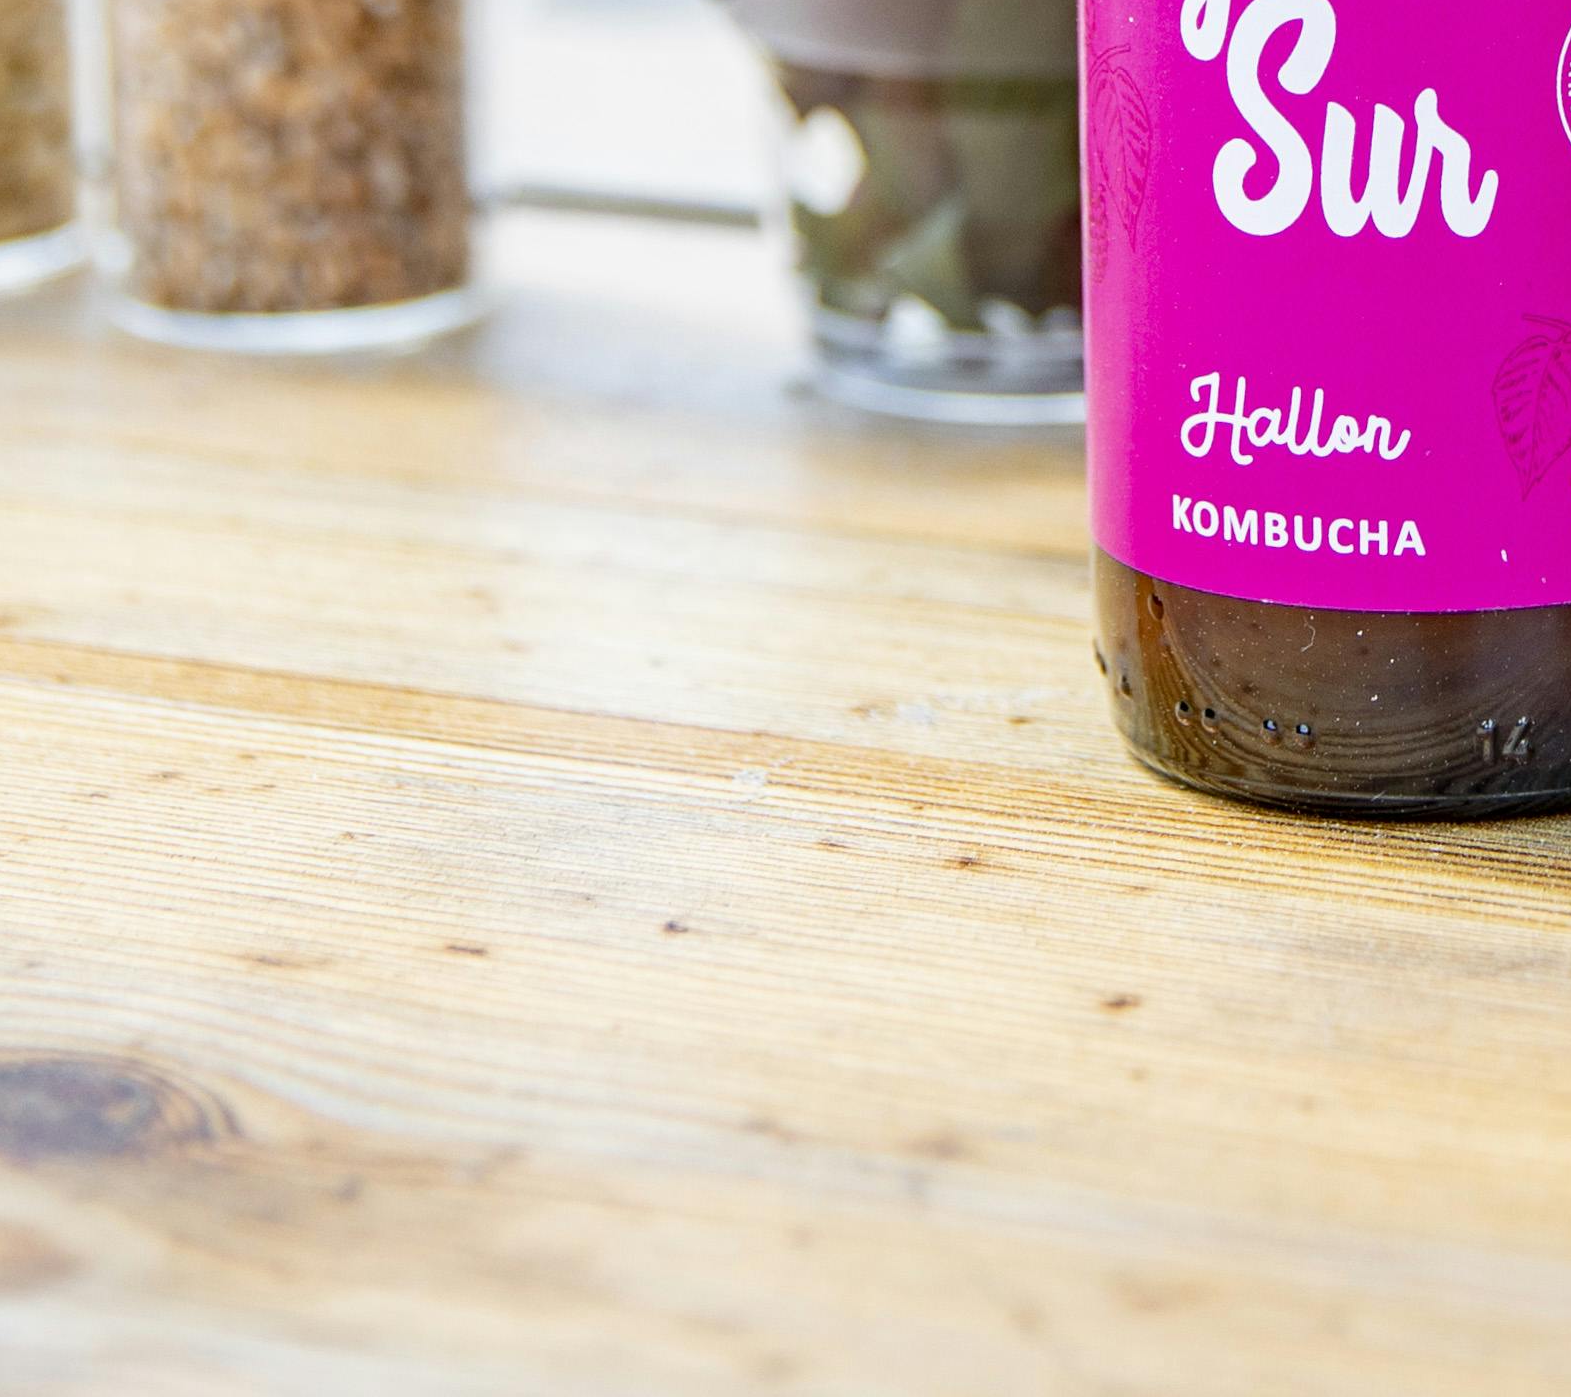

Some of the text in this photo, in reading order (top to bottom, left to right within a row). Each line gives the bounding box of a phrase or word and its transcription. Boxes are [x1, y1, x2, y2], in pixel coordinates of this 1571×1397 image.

[1354, 79, 1388, 110] FK
[1180, 370, 1412, 466] Hallon
[1172, 493, 1427, 556] KOMBUCHA
